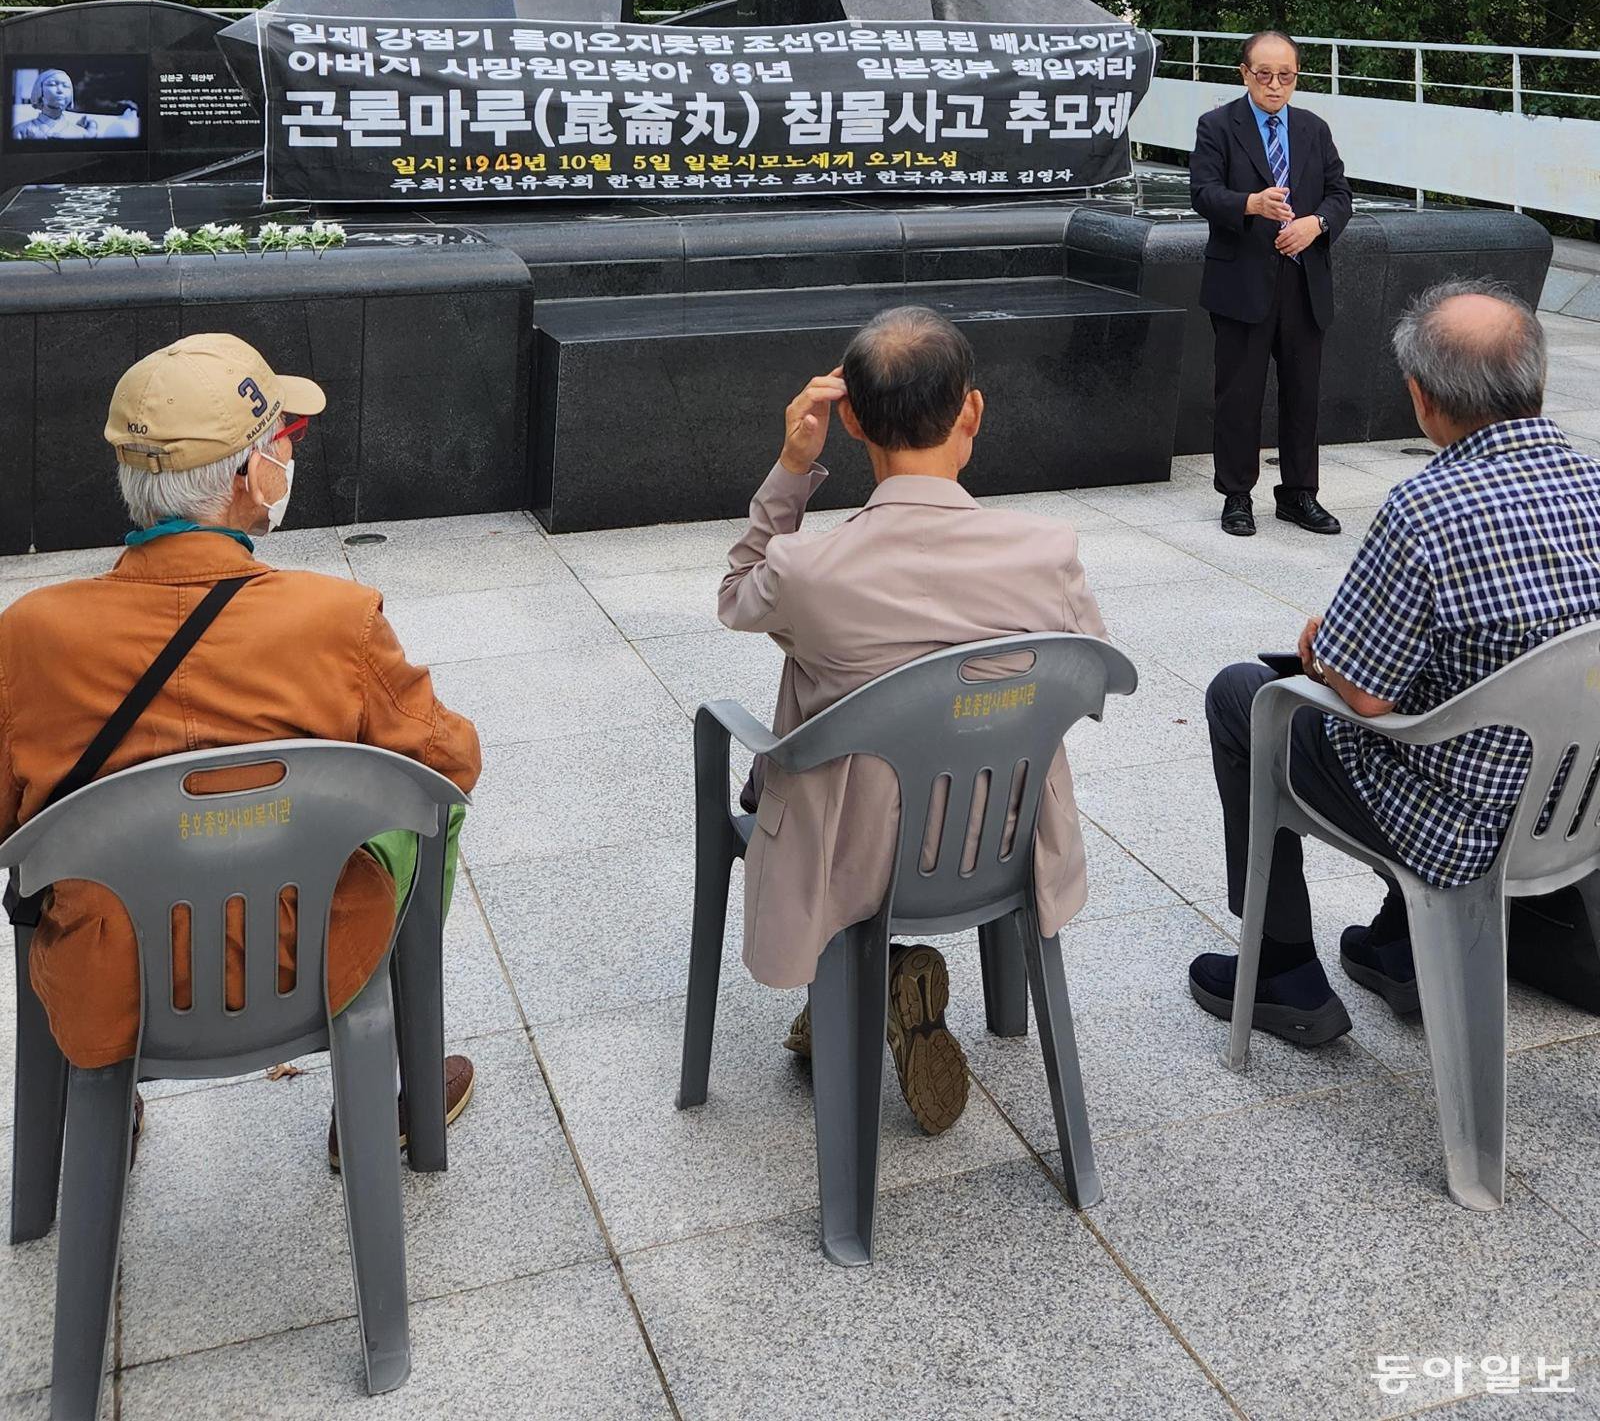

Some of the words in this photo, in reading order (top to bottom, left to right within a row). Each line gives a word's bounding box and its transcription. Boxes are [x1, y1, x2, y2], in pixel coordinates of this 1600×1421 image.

[287, 23, 367, 49] 일제
[375, 28, 494, 51] 강점기
[509, 28, 735, 56] 돌아오지못한
[988, 30, 1137, 55] 배사고이다
[287, 50, 421, 77] 아버지
[437, 57, 693, 83] 사망원인찾아
[708, 59, 794, 84] 83년
[856, 56, 1000, 80] 일본정부
[1011, 55, 1137, 80] 책임져라
[782, 89, 989, 145] 침몰사고
[1005, 90, 1132, 144] 추모제
[559, 153, 613, 172] 10월
[633, 153, 671, 171] 5일
[864, 150, 958, 168] 오키노섬
[605, 173, 783, 190] 한일문화연구소
[792, 170, 867, 186] 조사단
[876, 169, 1009, 186] 한국유족대표
[1017, 168, 1074, 184] 김영자
[238, 377, 267, 417] 3
